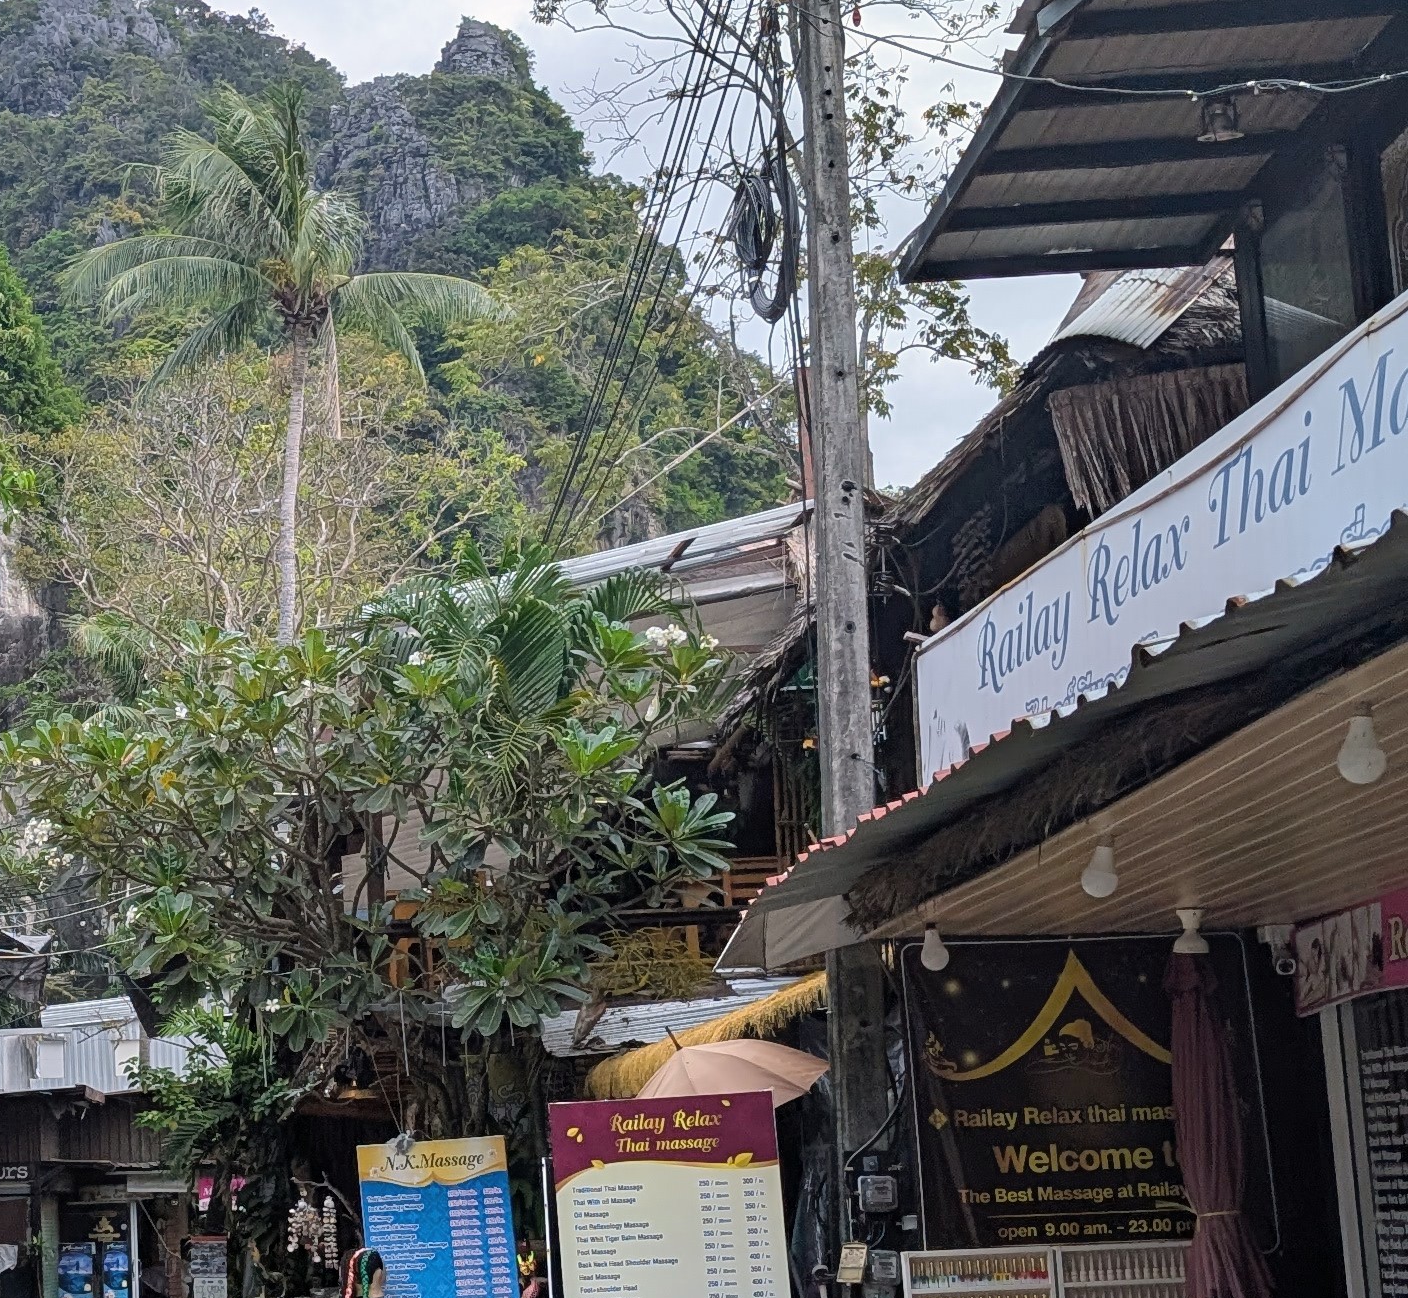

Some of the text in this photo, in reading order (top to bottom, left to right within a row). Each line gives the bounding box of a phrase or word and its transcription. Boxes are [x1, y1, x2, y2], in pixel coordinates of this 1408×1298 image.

[977, 590, 1072, 695] Railay
[1086, 514, 1191, 627] Relax
[1208, 411, 1312, 550] Thai
[610, 1108, 723, 1135] Railay Relax
[954, 1108, 1018, 1130] Railay
[1023, 1106, 1083, 1125] Relax
[1088, 1104, 1126, 1124] thai
[615, 1137, 720, 1153] Thai massage
[992, 1143, 1155, 1174] Welcome
[617, 1184, 643, 1192] Massage
[959, 1188, 991, 1204] The
[994, 1187, 1035, 1203] Best
[1038, 1185, 1114, 1204] Massage
[1117, 1185, 1135, 1199] at
[610, 1197, 636, 1205] Massage
[637, 1233, 663, 1241] Massage
[998, 1225, 1039, 1239] open
[1045, 1223, 1080, 1237] 9.00
[1083, 1222, 1114, 1236] am.
[1128, 1219, 1173, 1234] 23.00
